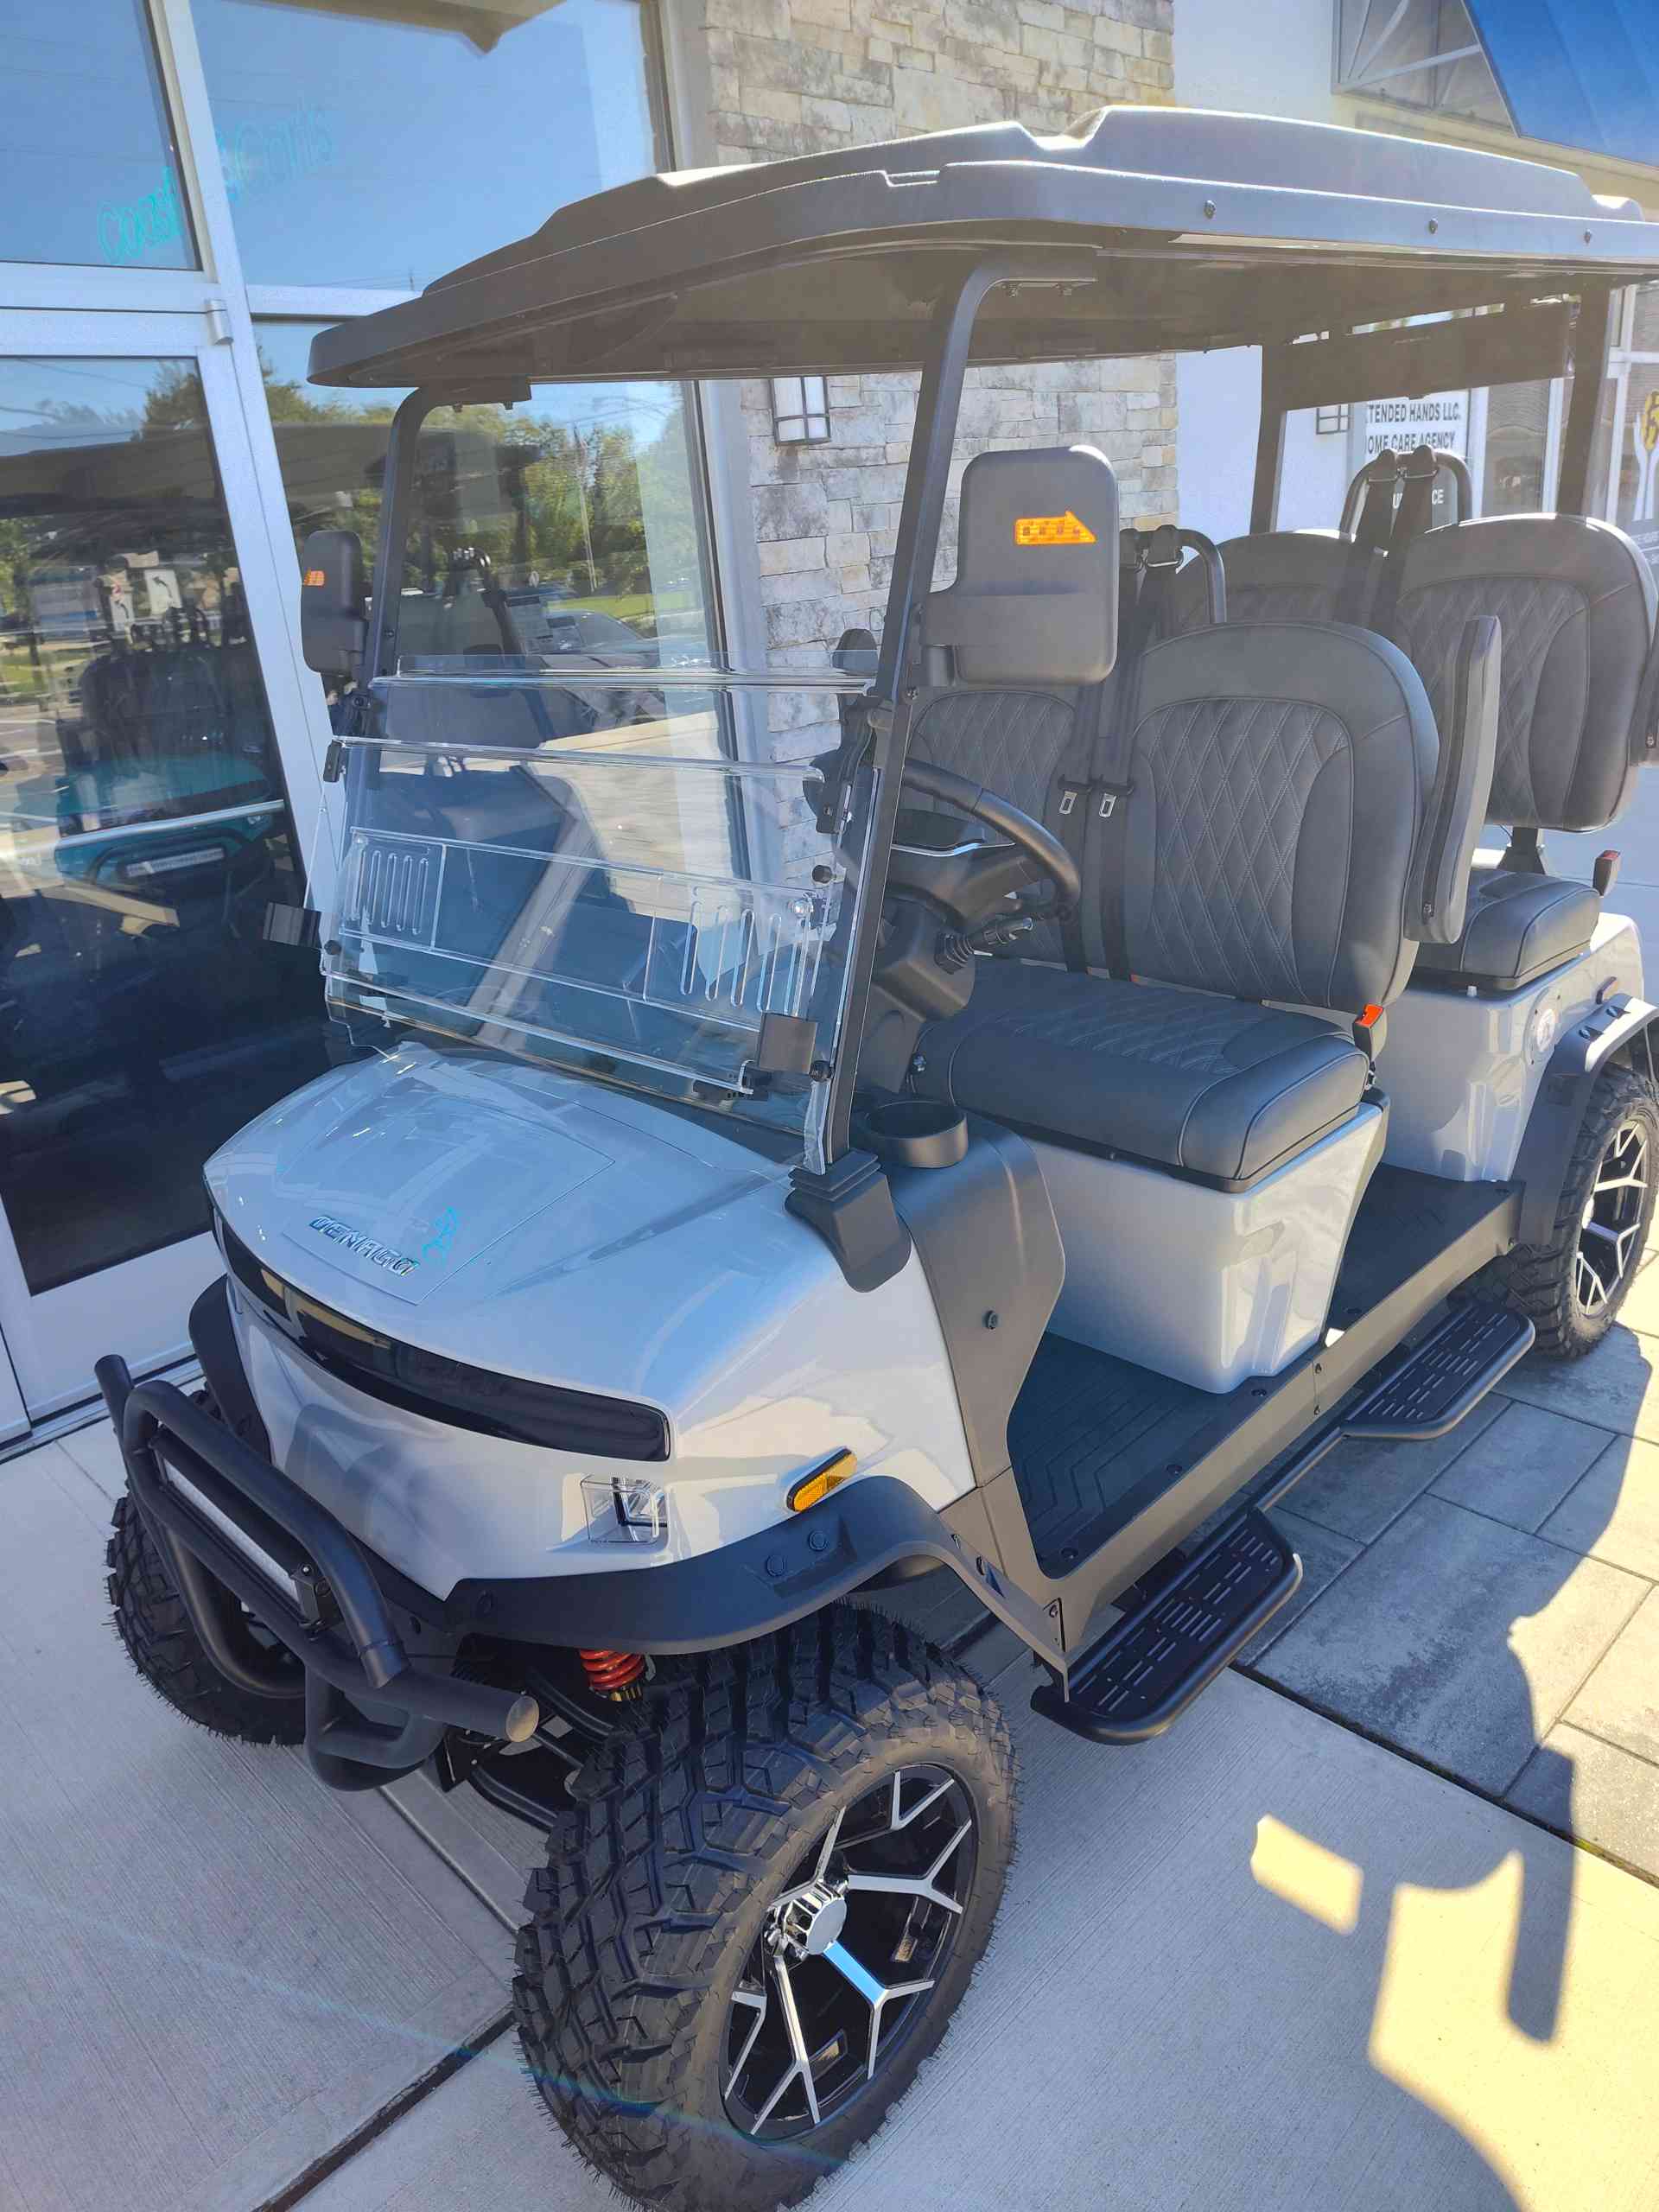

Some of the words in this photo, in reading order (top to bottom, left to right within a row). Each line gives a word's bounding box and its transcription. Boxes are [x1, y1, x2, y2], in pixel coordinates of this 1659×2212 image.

[1365, 403, 1407, 423] TENDED
[1408, 402, 1441, 422] HANDS
[1367, 435, 1389, 454] OME
[1390, 432, 1416, 452] CARE
[1420, 430, 1456, 450] AGENCY
